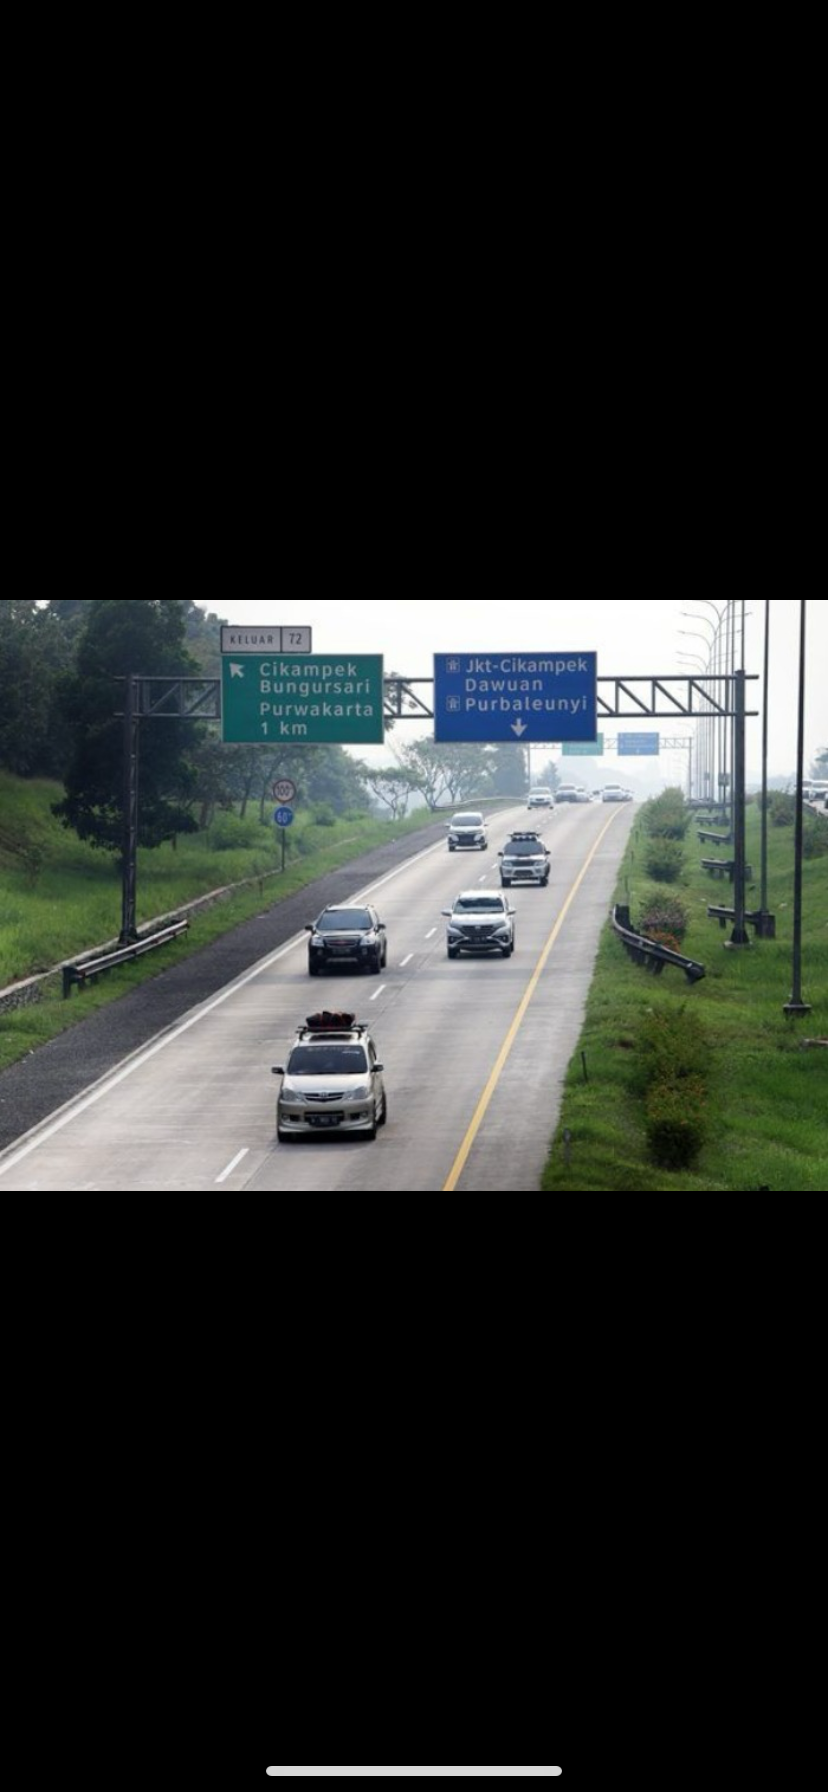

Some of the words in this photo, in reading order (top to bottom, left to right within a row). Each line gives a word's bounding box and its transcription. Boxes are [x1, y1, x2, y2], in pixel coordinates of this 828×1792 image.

[230, 635, 274, 645] KELUAR
[289, 633, 303, 645] 72
[259, 662, 357, 680] Cikampek
[466, 657, 588, 675] Jkt-Cikampek
[260, 680, 371, 697] Bungursari
[465, 678, 543, 692] Dawuan
[259, 702, 373, 717] Purwakarta
[465, 696, 588, 714] Purbaleunyi
[261, 722, 269, 735] 1
[280, 721, 308, 735] km
